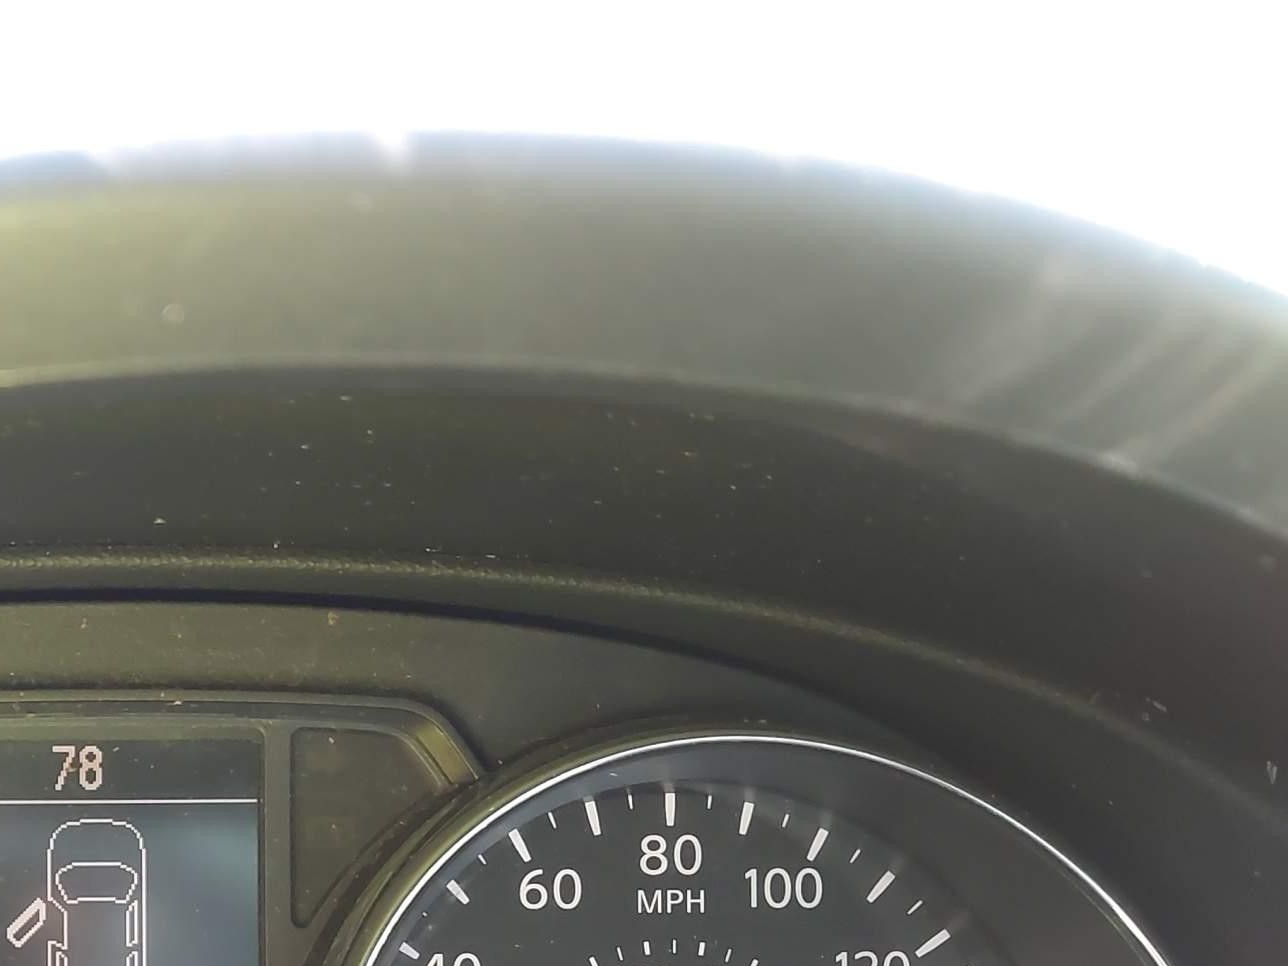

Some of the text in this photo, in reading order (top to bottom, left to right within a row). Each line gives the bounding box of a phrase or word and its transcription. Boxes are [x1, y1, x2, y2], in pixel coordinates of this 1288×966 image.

[52, 745, 103, 791] 78
[639, 834, 702, 876] 80
[517, 868, 583, 911] 60
[637, 889, 705, 914] MPH
[744, 867, 823, 909] 100
